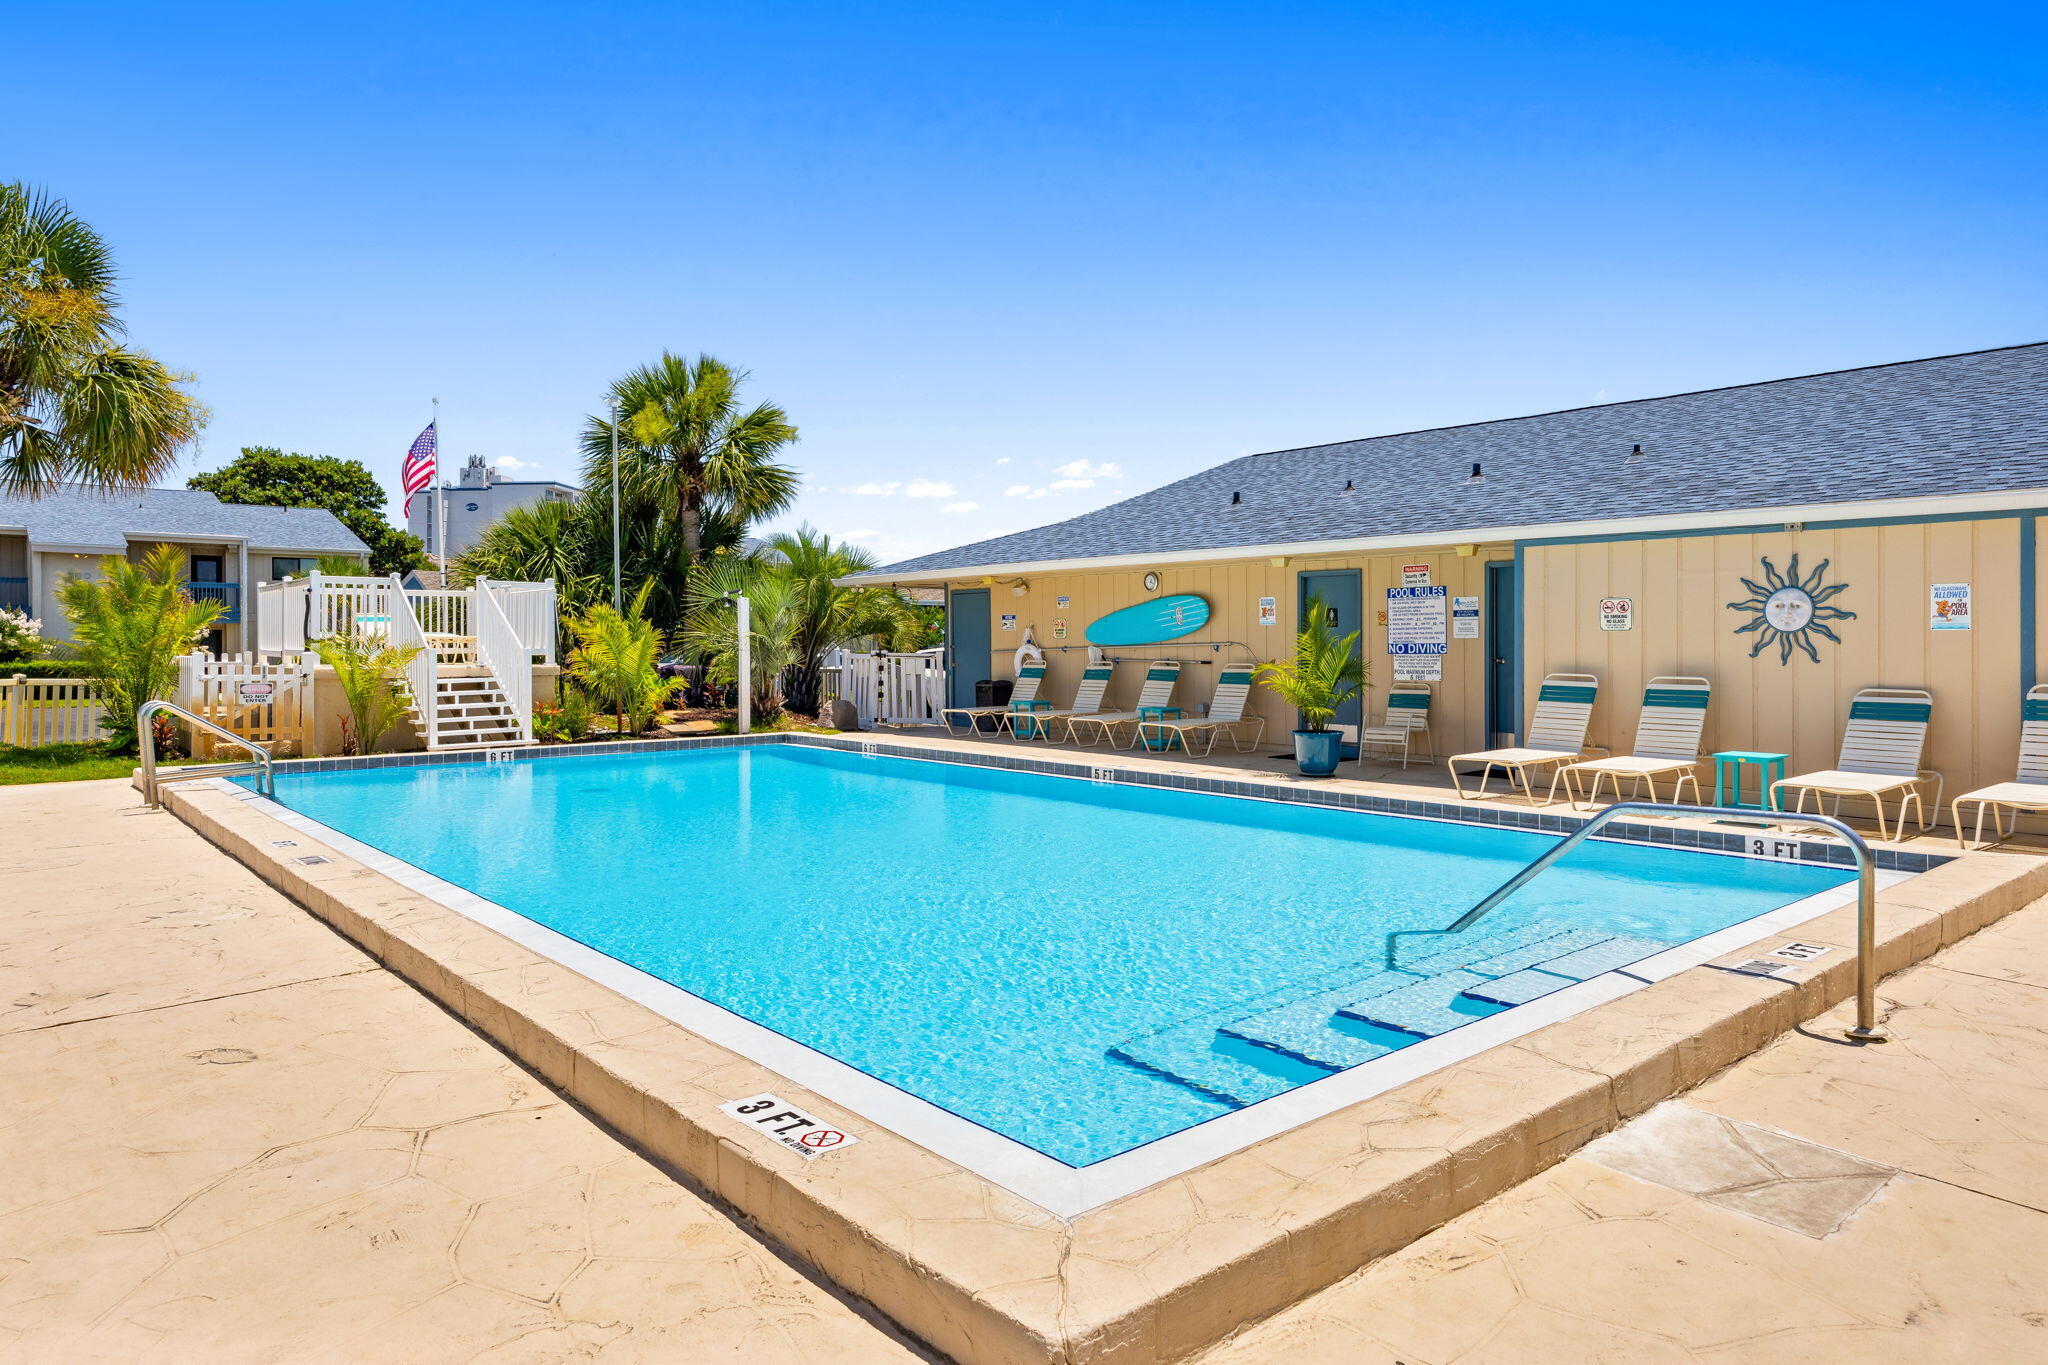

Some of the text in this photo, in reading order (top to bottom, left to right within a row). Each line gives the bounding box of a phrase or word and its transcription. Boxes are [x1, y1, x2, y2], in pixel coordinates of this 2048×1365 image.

[1390, 586, 1444, 597] POOL RULES
[1389, 644, 1447, 653] NO DIVING
[490, 751, 512, 762] 6 FT
[1094, 768, 1113, 780] 5 FT
[1753, 840, 1764, 855] 3
[737, 1101, 815, 1135] 3 FT.
